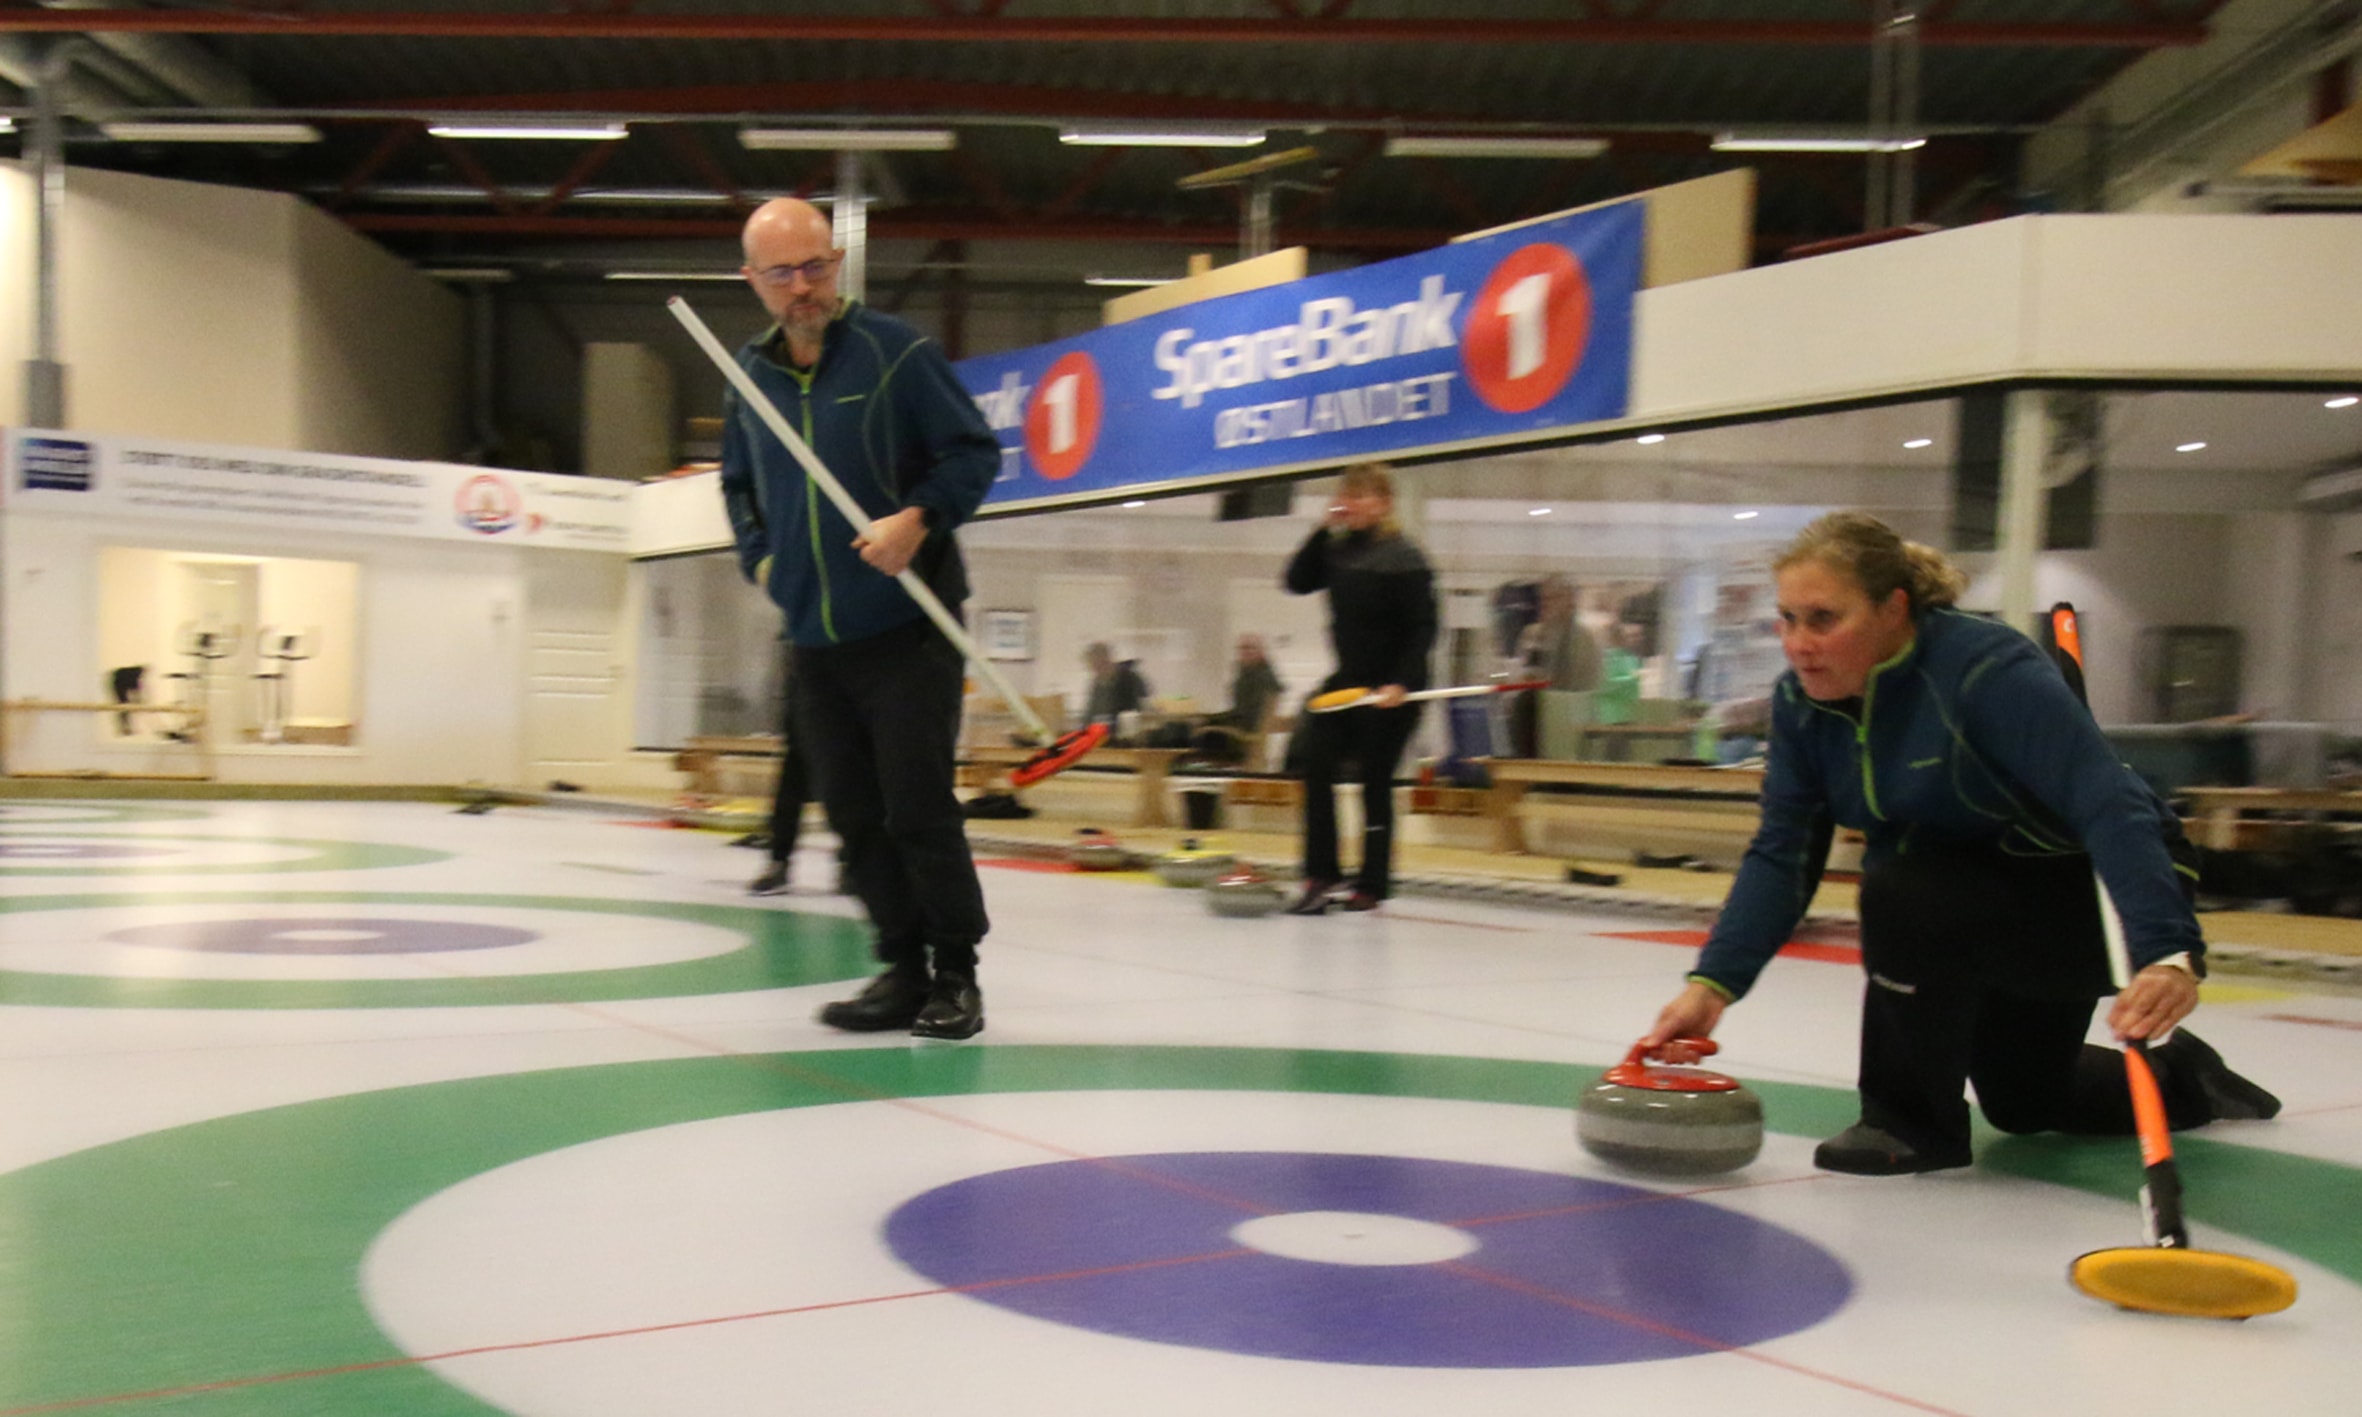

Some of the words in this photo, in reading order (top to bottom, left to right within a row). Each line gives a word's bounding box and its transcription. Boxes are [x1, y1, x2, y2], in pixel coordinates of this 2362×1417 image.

[1151, 274, 1465, 409] SpareBank
[1495, 273, 1553, 380] 1
[1042, 373, 1080, 455] 1
[1213, 371, 1457, 449] ØSTLANDET
